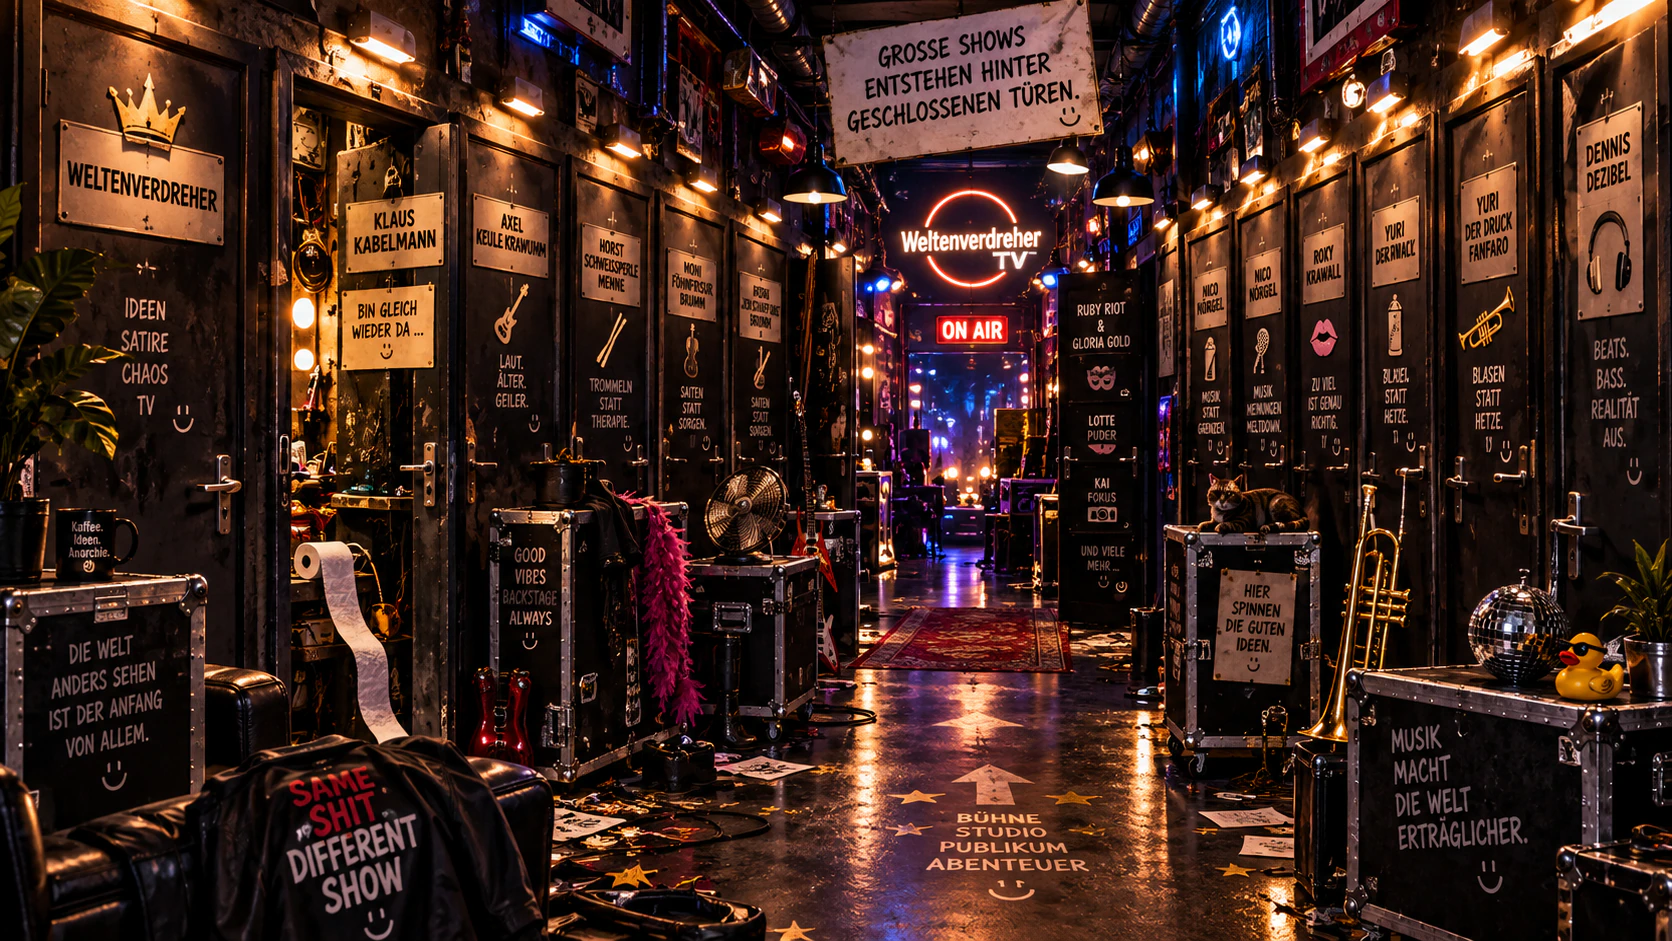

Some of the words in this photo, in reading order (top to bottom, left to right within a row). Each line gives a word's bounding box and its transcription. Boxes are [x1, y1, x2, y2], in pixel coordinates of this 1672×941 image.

[878, 37, 950, 68] GROSSE
[959, 25, 1025, 55] SHOWS
[864, 64, 972, 100] ENTSTEHEN
[981, 52, 1051, 82] HINTER
[847, 90, 1000, 133] GESCHLOSSENEN
[1008, 79, 1080, 108] TÜREN.
[1586, 131, 1630, 168] DENNIS
[1586, 160, 1632, 193] DEZIBEL
[68, 160, 218, 213] WELTENVERDREHER
[1476, 191, 1499, 216] YURI
[374, 209, 415, 230] KLAUS
[501, 213, 524, 233] AXEL
[1465, 220, 1481, 242] DER
[1484, 212, 1512, 238] DRUCK
[476, 228, 503, 248] KEULE
[901, 226, 1041, 253] Weltenverdreher
[1385, 220, 1404, 242] YURI
[354, 229, 436, 254] KABELMANN
[600, 238, 624, 258] HORST
[1469, 238, 1509, 262] FANFARO
[992, 252, 1030, 270] TV
[1314, 245, 1334, 265] ROXY
[684, 262, 702, 278] MONI
[1254, 266, 1271, 283] NICO
[1306, 264, 1341, 286] KRAWALL
[598, 274, 624, 292] MENNE
[1202, 282, 1218, 298] NICO
[125, 298, 166, 320] IDEEN
[357, 303, 376, 320] BIN
[380, 300, 417, 316] GLEICH
[1077, 303, 1101, 316] RUBY
[1105, 302, 1126, 315] RIOT
[352, 323, 391, 339] WIEDER
[396, 322, 410, 338] DA
[942, 321, 967, 339] ON
[972, 321, 1002, 339] AIR
[1097, 320, 1104, 332] &
[121, 330, 168, 353] SATIRE
[1073, 336, 1104, 350] GLORIA
[1107, 334, 1130, 348] GOLD
[1594, 337, 1630, 360] BEATS.
[500, 354, 524, 370] LAUT.
[122, 362, 168, 385] CHAOS
[497, 368, 526, 389] ÄLTER.
[1472, 365, 1504, 384] BLASEN
[1596, 368, 1626, 390] BASS.
[589, 378, 632, 394] TROMMELN
[680, 386, 704, 399] SAITEN
[1254, 385, 1273, 399] MUSIK
[1311, 377, 1321, 392] ZU
[1322, 376, 1336, 391] VIEL
[137, 394, 154, 416] TV
[495, 394, 528, 408] GEILER.
[600, 396, 622, 412] STATT
[1308, 396, 1318, 411] IST
[1320, 395, 1342, 410] GENAU
[1385, 388, 1407, 405] STATT
[1476, 389, 1500, 408] STATT
[682, 402, 702, 414] STATT
[1203, 406, 1220, 418] STATT
[1592, 392, 1640, 420] REALITÄT
[592, 414, 630, 429] THERAPIE.
[1088, 415, 1116, 427] LOTTE
[1246, 420, 1282, 433] MELTDOWN.
[1311, 414, 1338, 430] RICHTIG.
[1475, 412, 1502, 430] HETZE.
[1087, 429, 1116, 441] PUDER
[1603, 427, 1626, 448] AUS.
[1094, 478, 1110, 488] KAI
[1087, 492, 1116, 502] FOKUS
[72, 520, 104, 532] Kaffee.
[74, 534, 101, 545] Ideen.
[514, 546, 546, 564] GOOD
[1081, 546, 1099, 556] UND
[1102, 546, 1125, 557] VIELE
[1087, 560, 1110, 571] MEHR
[515, 568, 546, 586] VIBES
[502, 589, 557, 606] BACKSTAGE
[1244, 584, 1270, 600] HIER
[508, 609, 552, 626] ALWAYS
[1232, 601, 1281, 618] SPINNEN
[1225, 618, 1244, 634] DIE
[1248, 620, 1285, 637] GUTEN
[69, 641, 92, 665] DIE
[96, 634, 134, 660] WELT
[1236, 636, 1272, 654] IDEEN.
[52, 671, 108, 700] ANDERS
[112, 662, 156, 688] SEHEN
[48, 708, 72, 732] IST
[76, 703, 104, 726] DER
[108, 690, 162, 718] ANFANG
[66, 735, 96, 759] VON
[100, 724, 150, 752] ALLEM.
[1391, 723, 1442, 754] MUSIK
[1394, 754, 1452, 786] MACHT
[290, 766, 376, 807] SAME
[1396, 792, 1422, 818] DIE
[1427, 786, 1472, 814] WELT
[310, 790, 376, 837] SHIT
[956, 810, 1042, 825] BÜHNE
[956, 827, 1048, 838] STUDIO
[1398, 816, 1528, 850] ERTRÄGLICHER.
[286, 814, 418, 884] DIFFERENT
[939, 842, 1068, 854] PUBLIKUM
[926, 858, 1090, 872] ABENTEUER
[322, 856, 403, 914] SHOW
